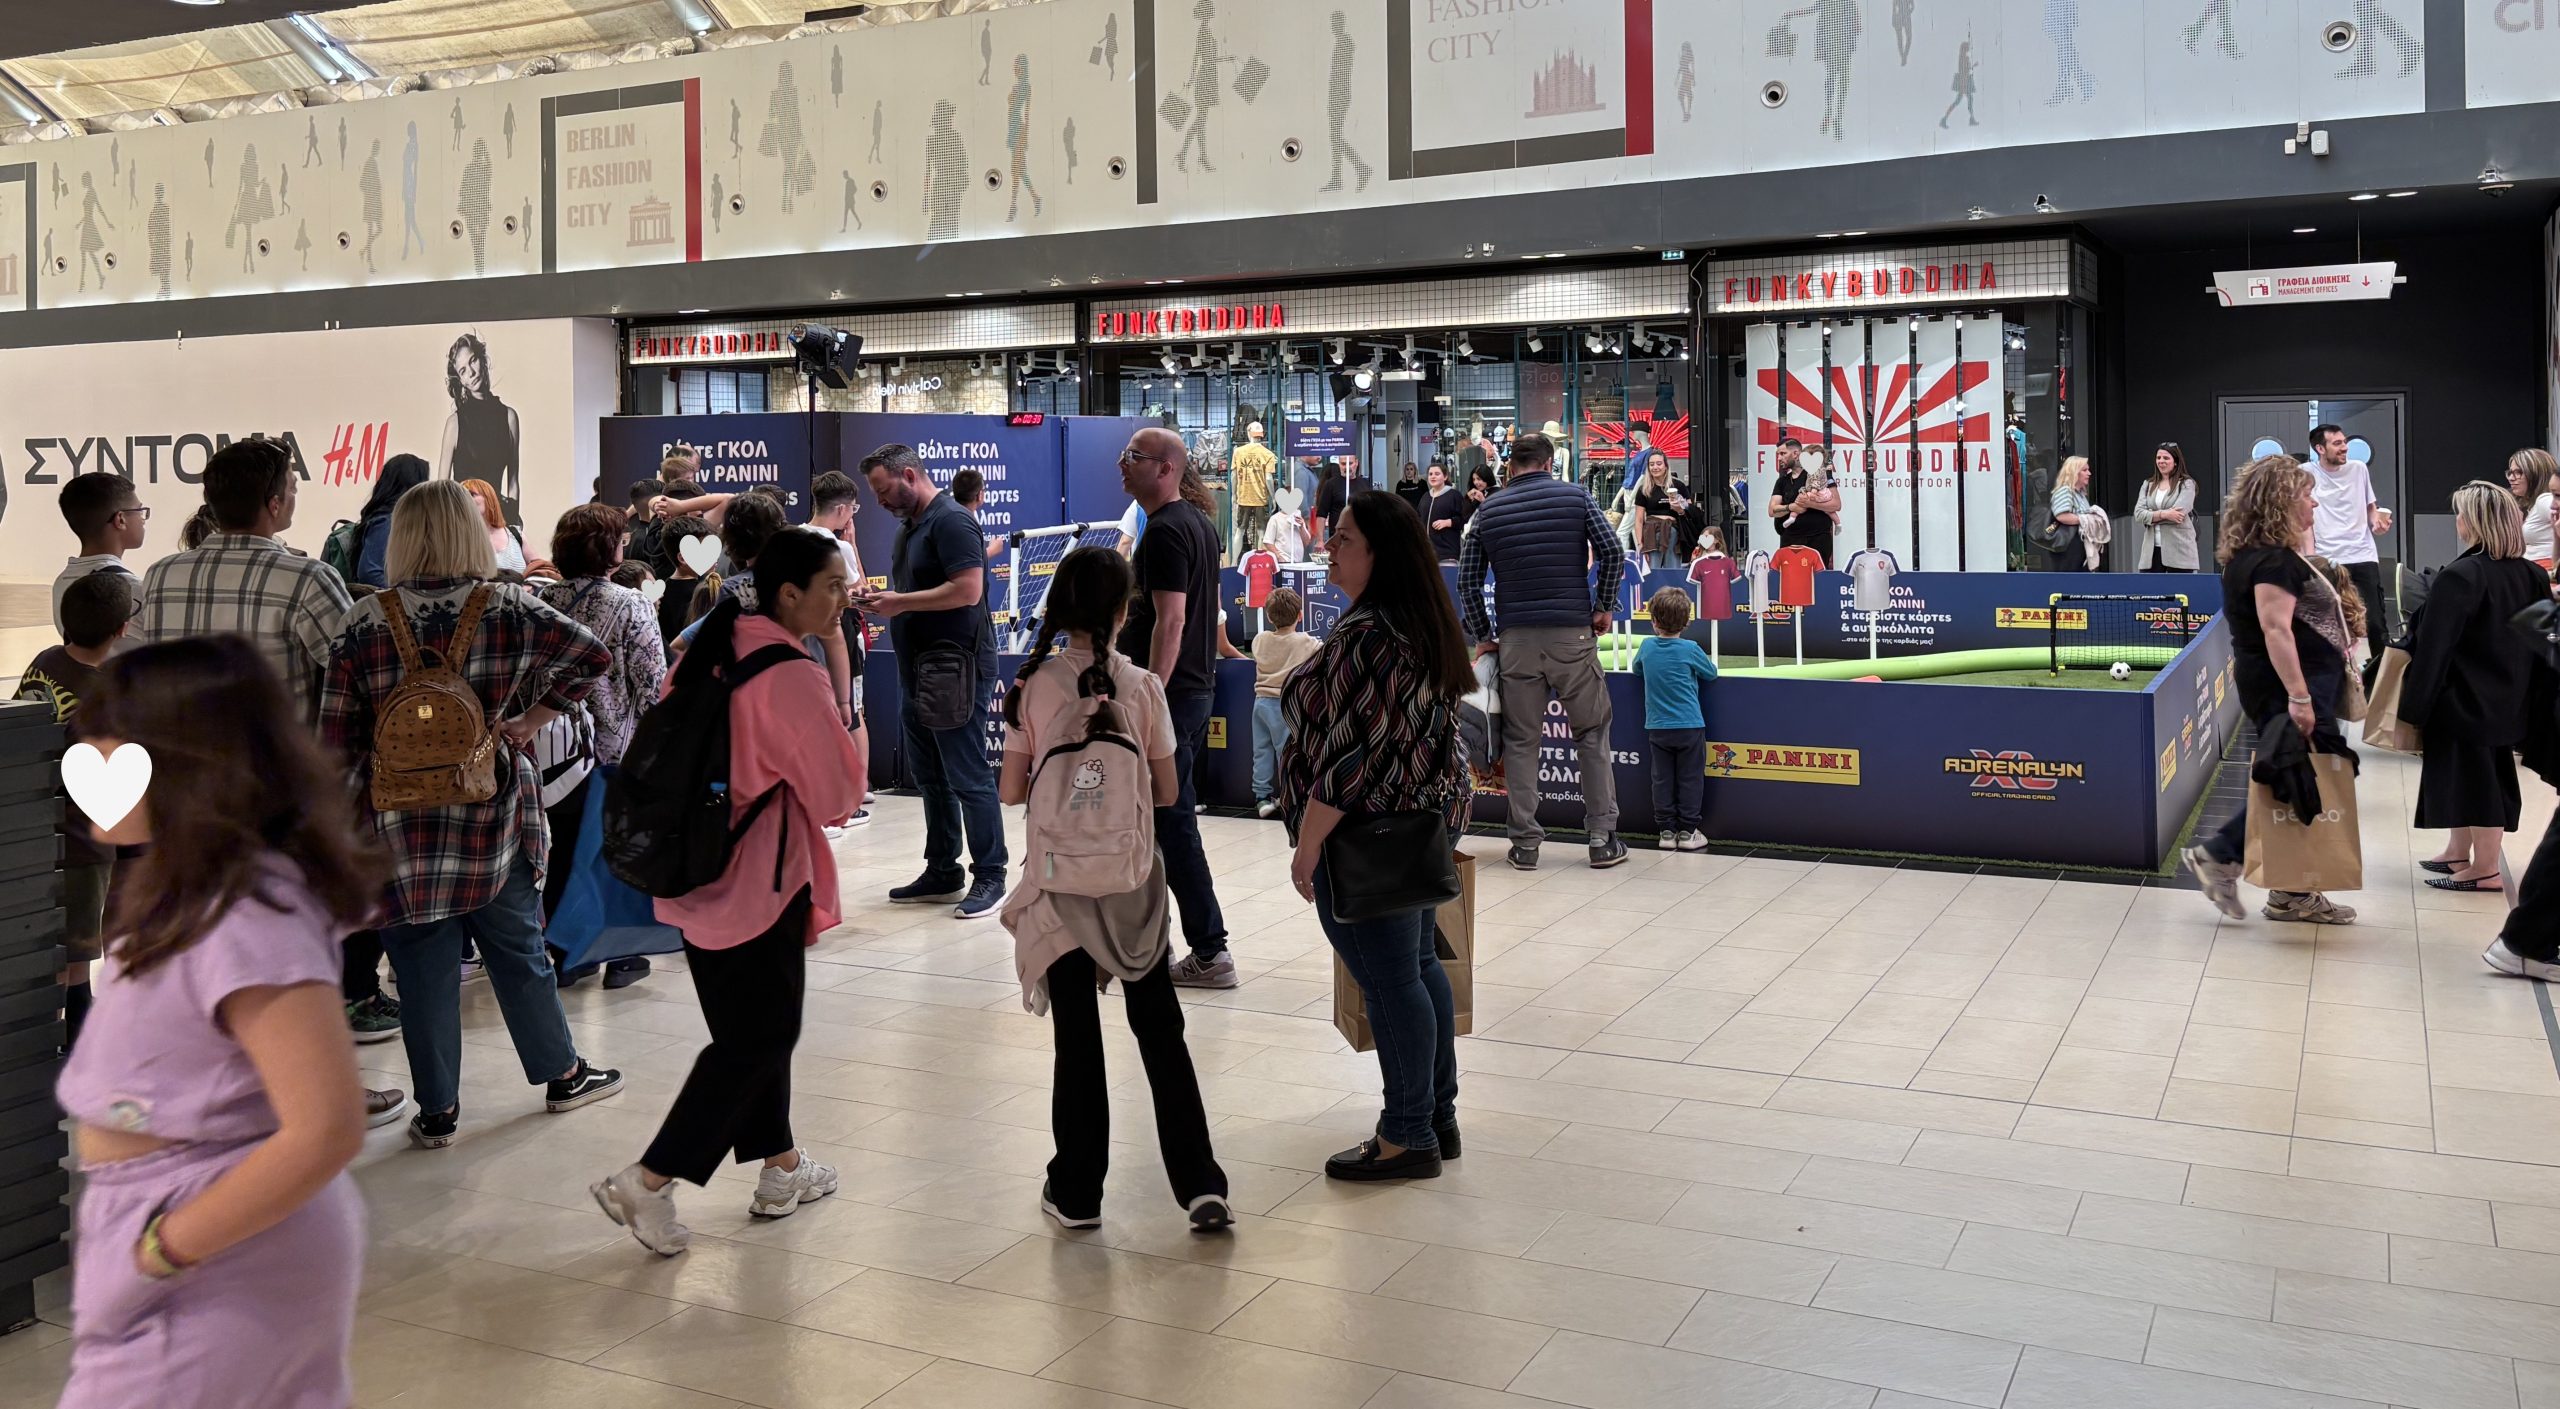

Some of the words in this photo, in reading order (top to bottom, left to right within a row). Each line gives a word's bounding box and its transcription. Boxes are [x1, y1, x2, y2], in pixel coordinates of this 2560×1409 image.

[1428, 0, 1565, 23] FASH
[1428, 29, 1502, 63] CITY
[567, 123, 635, 153] BERLIN
[567, 159, 652, 190] FASHION
[567, 202, 612, 228] CITY
[1725, 262, 1997, 304] FUNKYBUDDHA
[2277, 277, 2310, 287] ΓΡΑΦΕΙΑ
[2312, 275, 2351, 285] ΔΙΟΙΚΗΣΗΣ
[2278, 287, 2314, 296] MANAGEMENT
[2315, 286, 2338, 294] OFFICES
[1098, 303, 1285, 336] FUNKYBUDDHA
[635, 331, 780, 358] FUNKYBUDDHA
[24, 431, 312, 485] ΣΥΝΤΟΑ
[322, 421, 389, 487] H&M
[717, 440, 768, 459] ΓΚΟΛ
[918, 438, 959, 459] Βάλτε
[962, 442, 999, 459] ΓΚΟΛ
[714, 464, 778, 482] PANINI
[983, 484, 1020, 507] άρτες
[1736, 604, 1804, 613] ADNALY
[1889, 598, 1925, 609] ANINI
[1841, 610, 1850, 620] &
[1908, 610, 1952, 624] κάρτες
[1841, 622, 1850, 632] &
[2135, 612, 2214, 623] ADRENLYN
[1747, 749, 1852, 770] PANINI
[1944, 758, 2084, 778] ADRENALYN
[1971, 791, 2002, 799] OFFICIAL
[2272, 808, 2341, 825] peco
